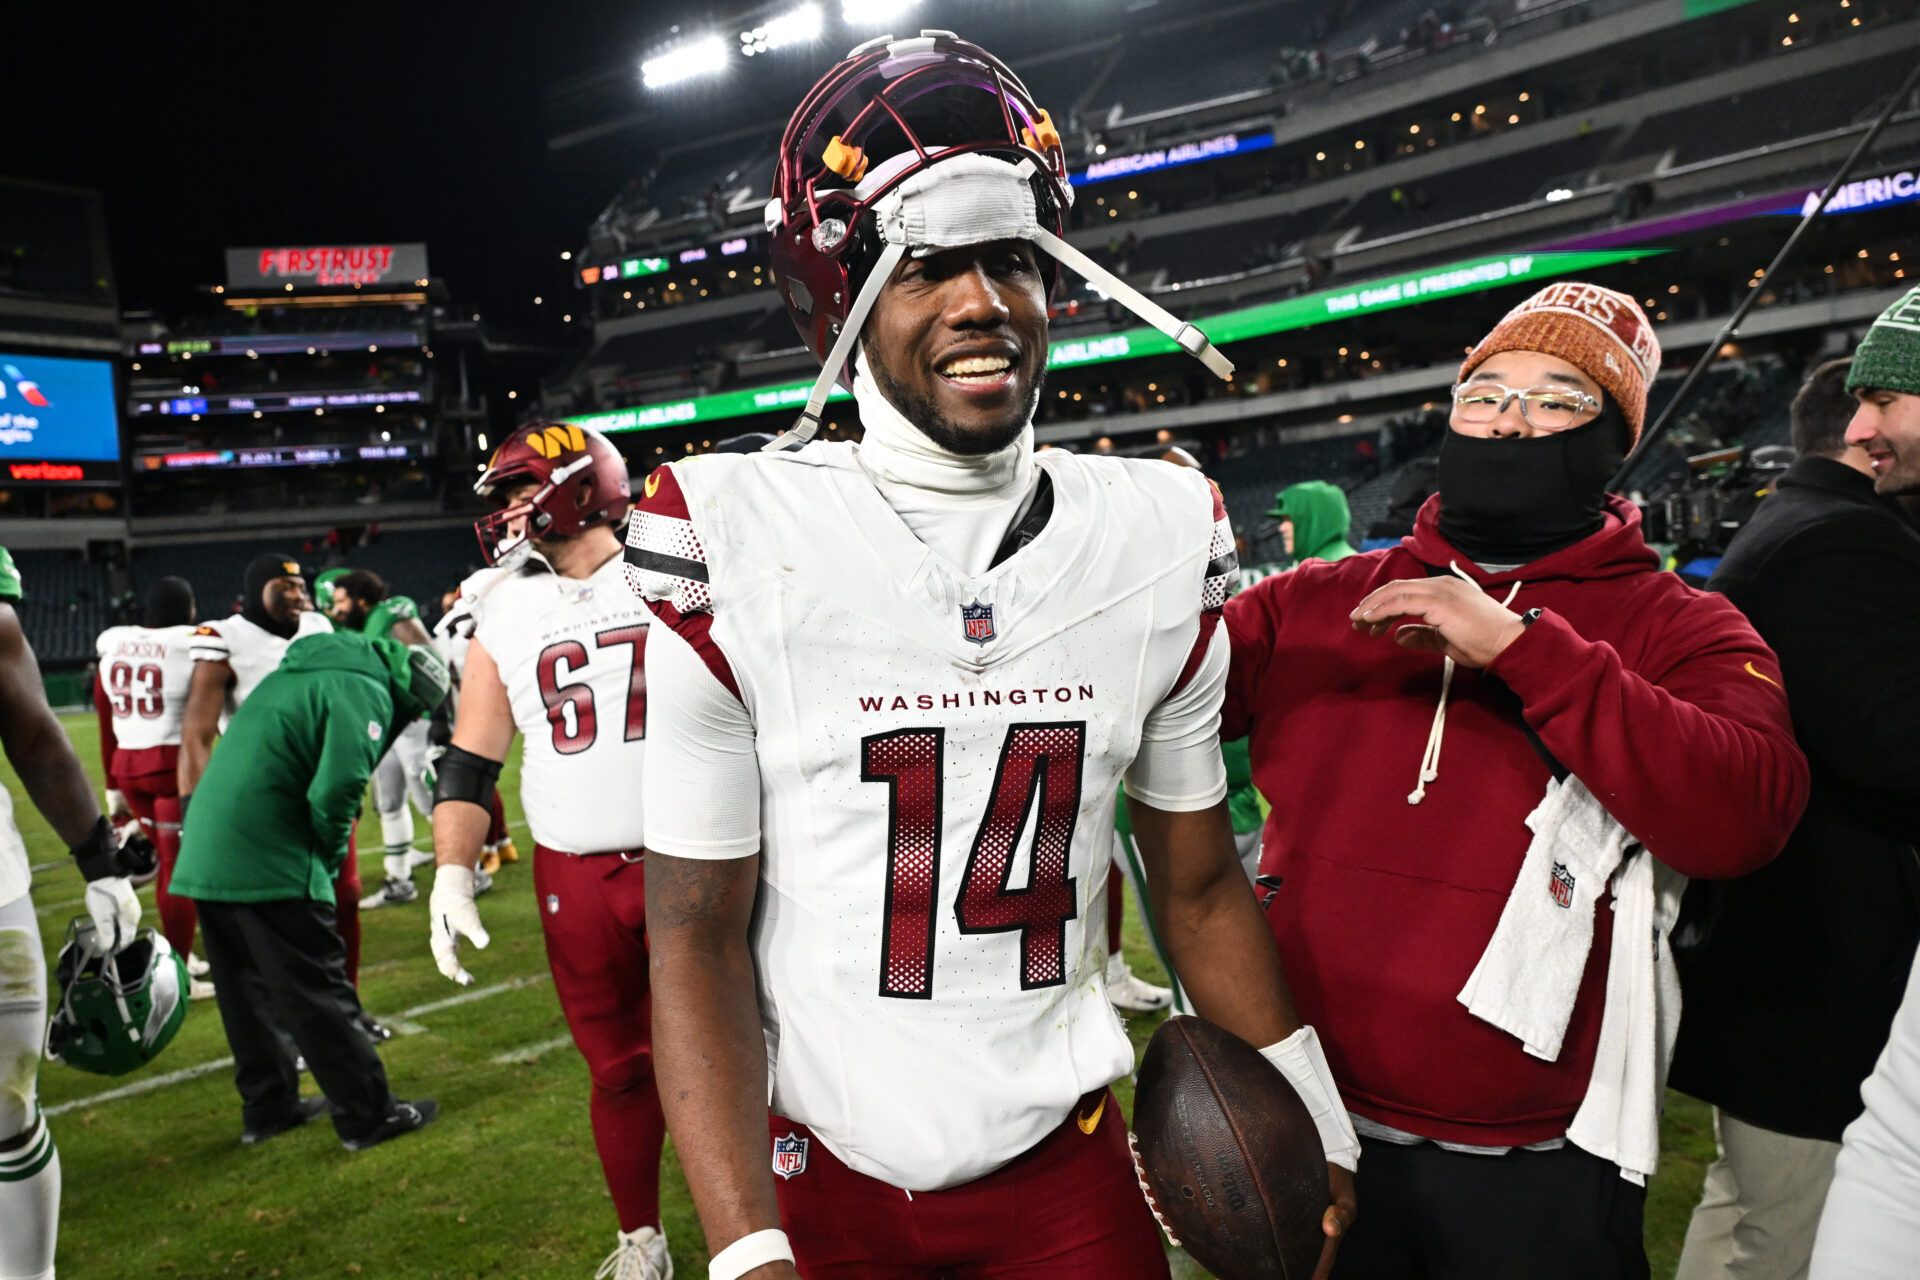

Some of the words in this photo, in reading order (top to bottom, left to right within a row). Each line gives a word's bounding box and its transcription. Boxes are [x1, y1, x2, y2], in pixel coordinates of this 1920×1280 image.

[1086, 150, 1166, 180] AMERICAN
[1167, 134, 1239, 163] AIRLINES
[1801, 171, 1920, 215] AMERIC
[1325, 292, 1359, 314] THIS
[1359, 283, 1401, 307] GAME
[1402, 279, 1419, 298] IS
[1419, 261, 1508, 294] PRESENTED
[1509, 255, 1533, 276] BY
[1052, 336, 1129, 364] AIRLINES
[638, 402, 697, 426] AIRLINES
[9, 461, 84, 480] verizon
[541, 609, 643, 641] WASHINGTON
[967, 620, 993, 638] NFL
[109, 660, 164, 719] 93
[536, 622, 651, 756] 67
[858, 684, 1094, 712] WASHINGTON
[860, 720, 1087, 1000] 14
[1550, 874, 1569, 907] NFL
[777, 1153, 801, 1171] NFL
